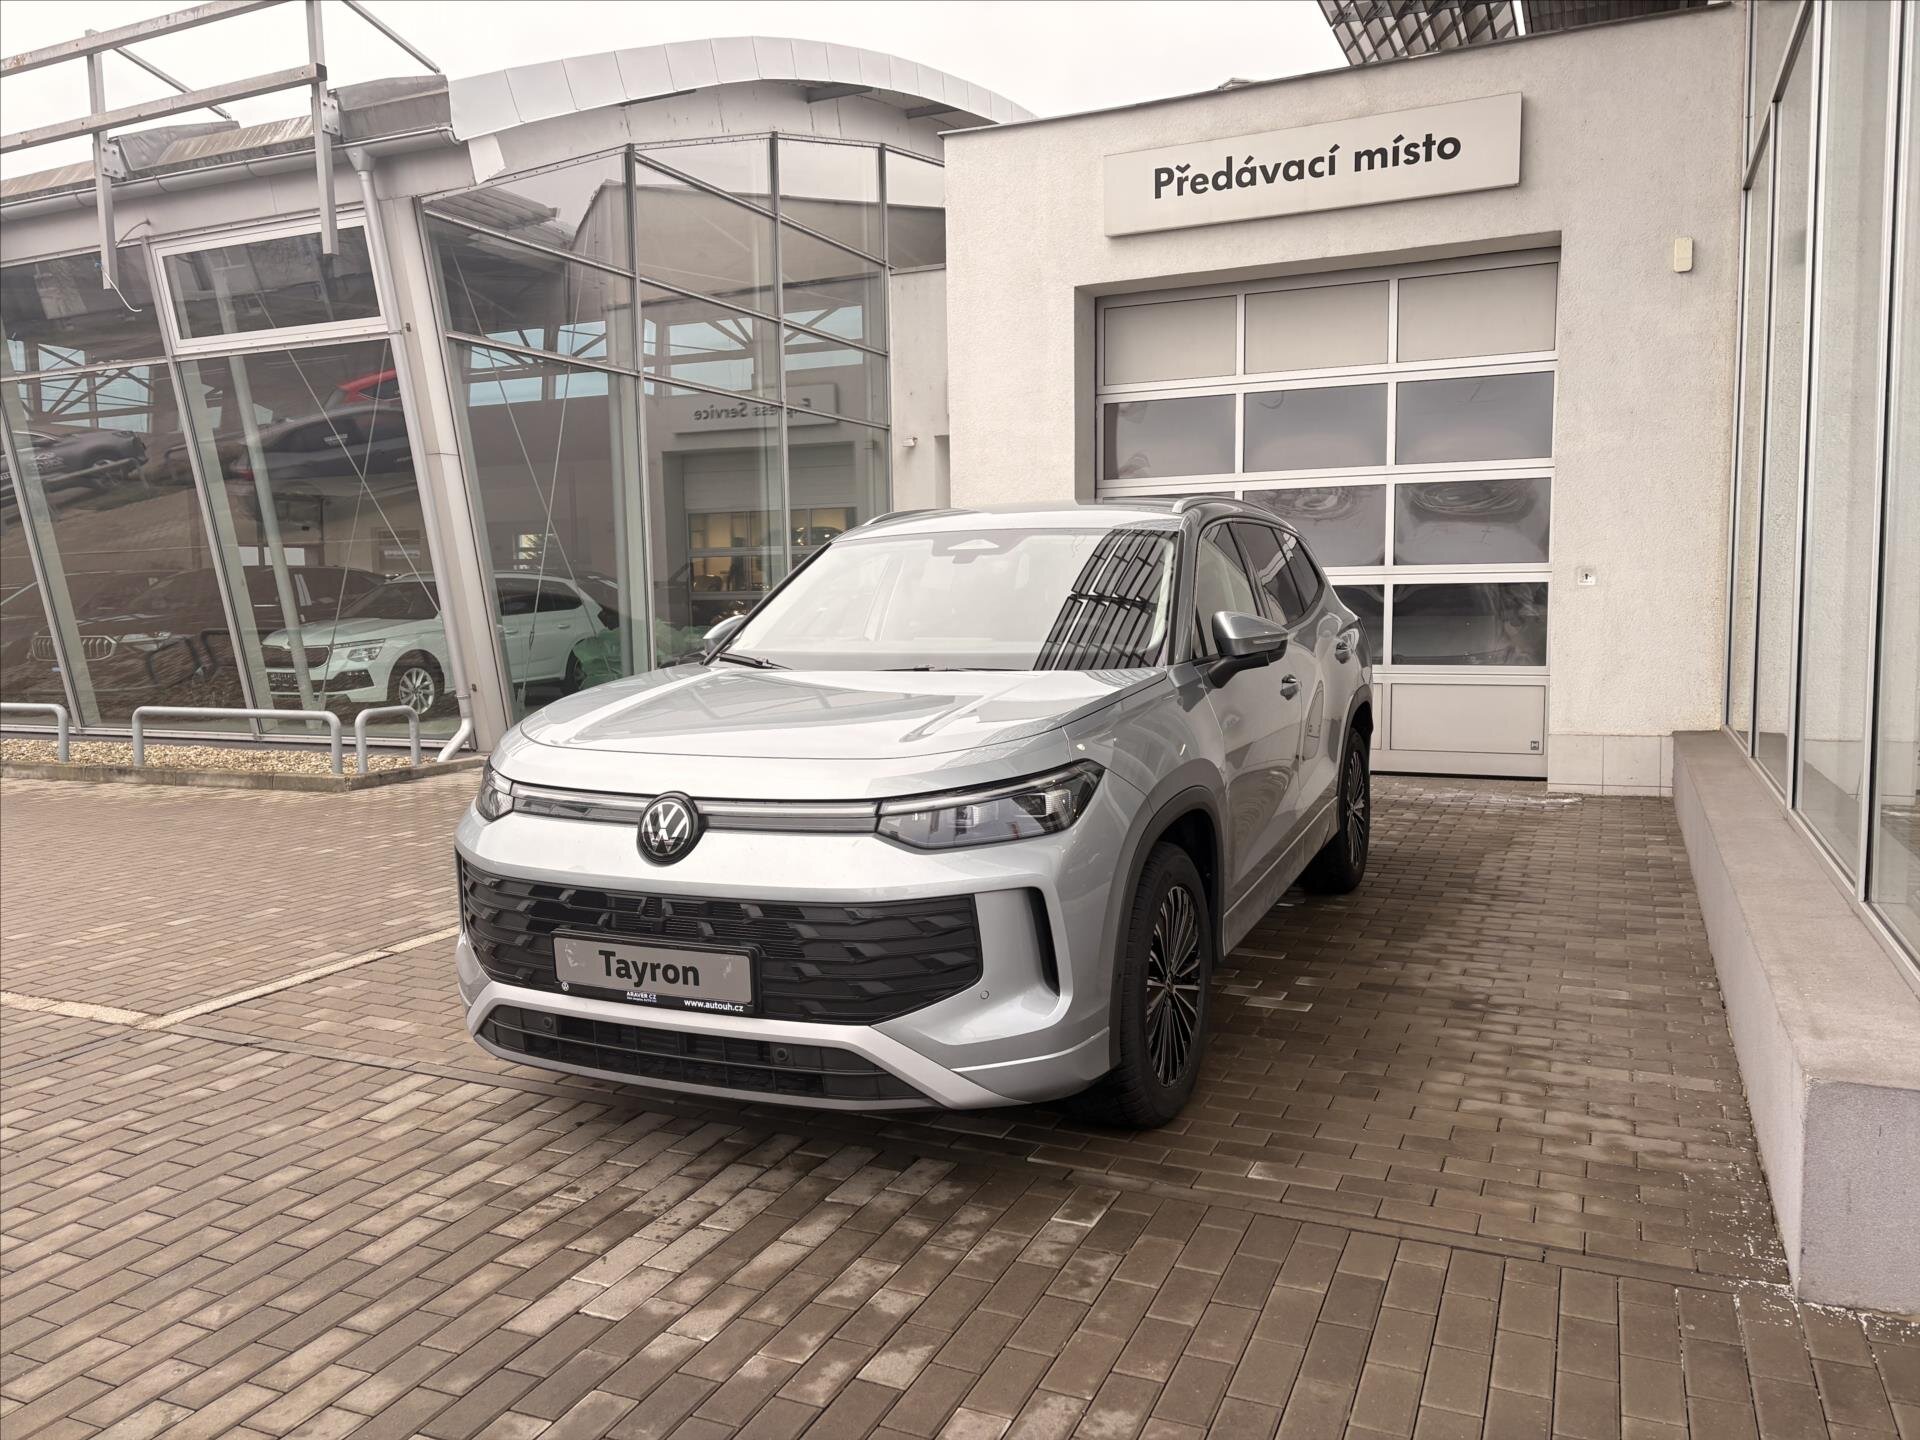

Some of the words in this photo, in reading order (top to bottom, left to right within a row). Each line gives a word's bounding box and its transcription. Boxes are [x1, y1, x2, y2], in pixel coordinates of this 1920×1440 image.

[1153, 144, 1341, 200] Předávací
[1353, 133, 1462, 172] místo
[598, 949, 701, 988] Tayron
[683, 999, 744, 1012] www.autouh.cz
